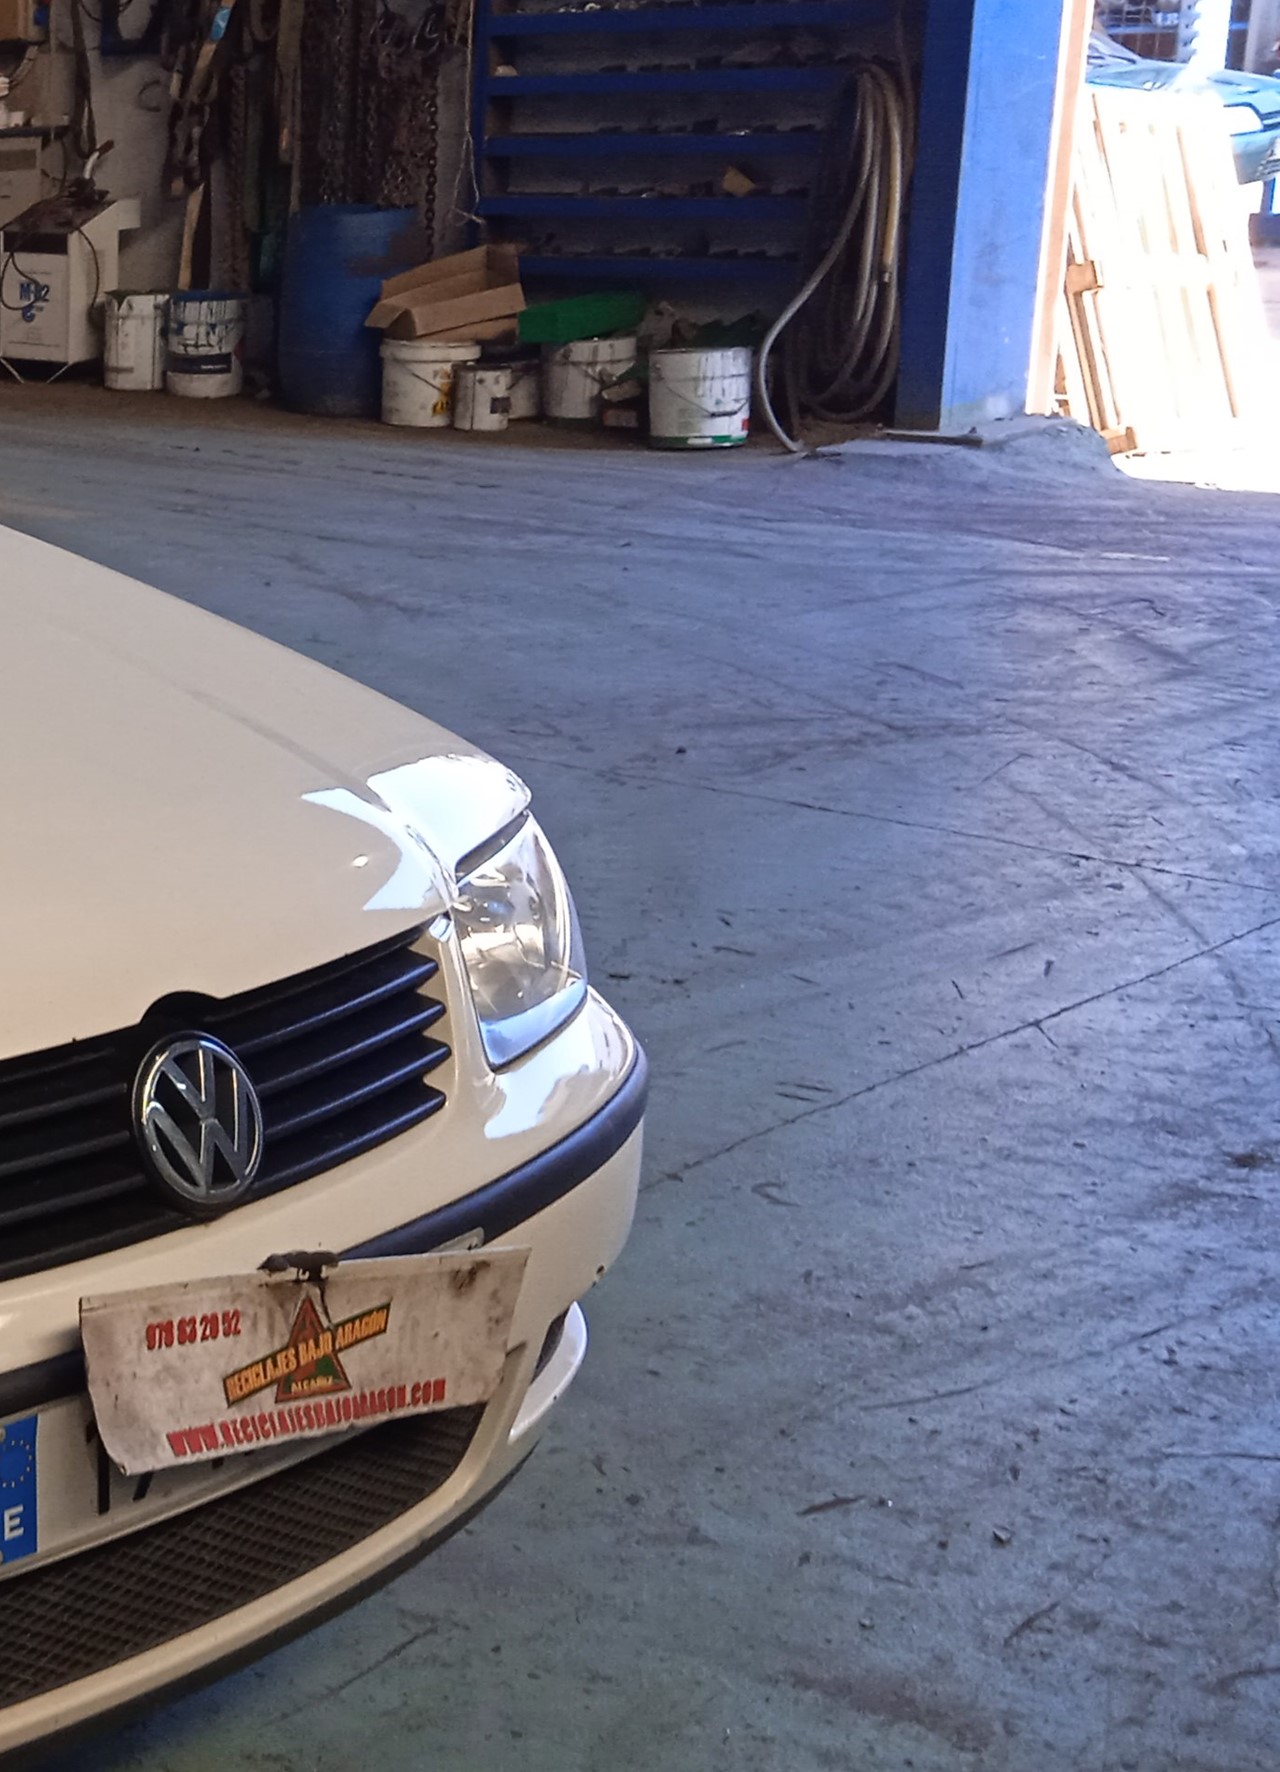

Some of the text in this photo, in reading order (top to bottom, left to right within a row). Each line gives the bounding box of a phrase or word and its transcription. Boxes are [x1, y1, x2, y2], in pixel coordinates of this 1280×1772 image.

[146, 1319, 174, 1351] 978
[222, 1308, 241, 1337] 52
[226, 1346, 297, 1402] RECICLAJES
[299, 1331, 333, 1366] BAJO
[3, 1504, 25, 1541] E
